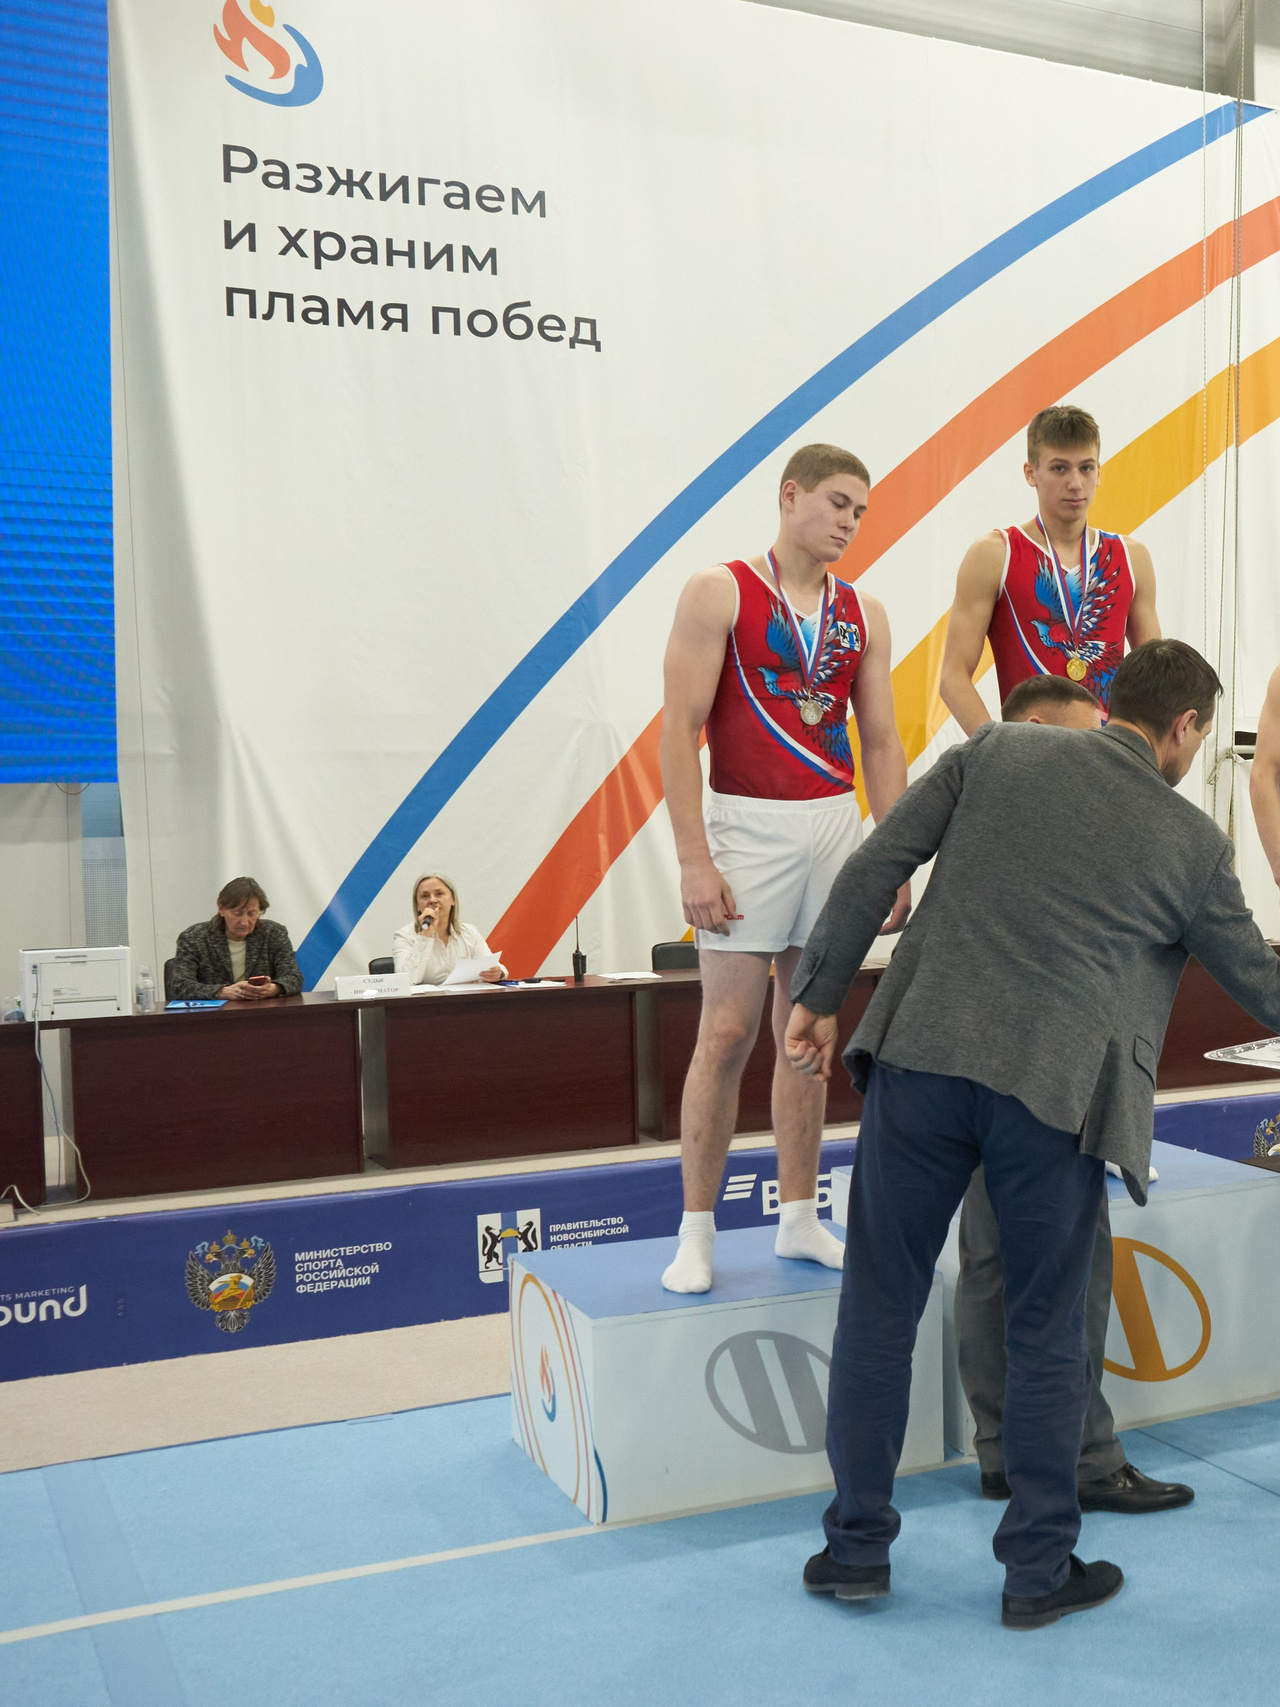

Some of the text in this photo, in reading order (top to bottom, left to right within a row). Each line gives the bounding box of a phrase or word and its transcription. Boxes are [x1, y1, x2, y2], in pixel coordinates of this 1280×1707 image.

[221, 143, 547, 218] Разжигаем
[223, 219, 499, 276] и храним
[225, 286, 602, 352] пламя побед
[550, 1216, 624, 1233] ПРАВИТЕЛЬСТВО
[550, 1224, 629, 1243] НОВОСИБИРСКОЙ
[294, 1241, 393, 1262] МИНИСТЕРСТВО
[295, 1258, 344, 1273] СПОРТА
[295, 1262, 380, 1284] РОССИЙСКОЙ
[15, 1285, 75, 1300] MARKETING
[296, 1276, 371, 1294] ФЕДЕРАЦИИ
